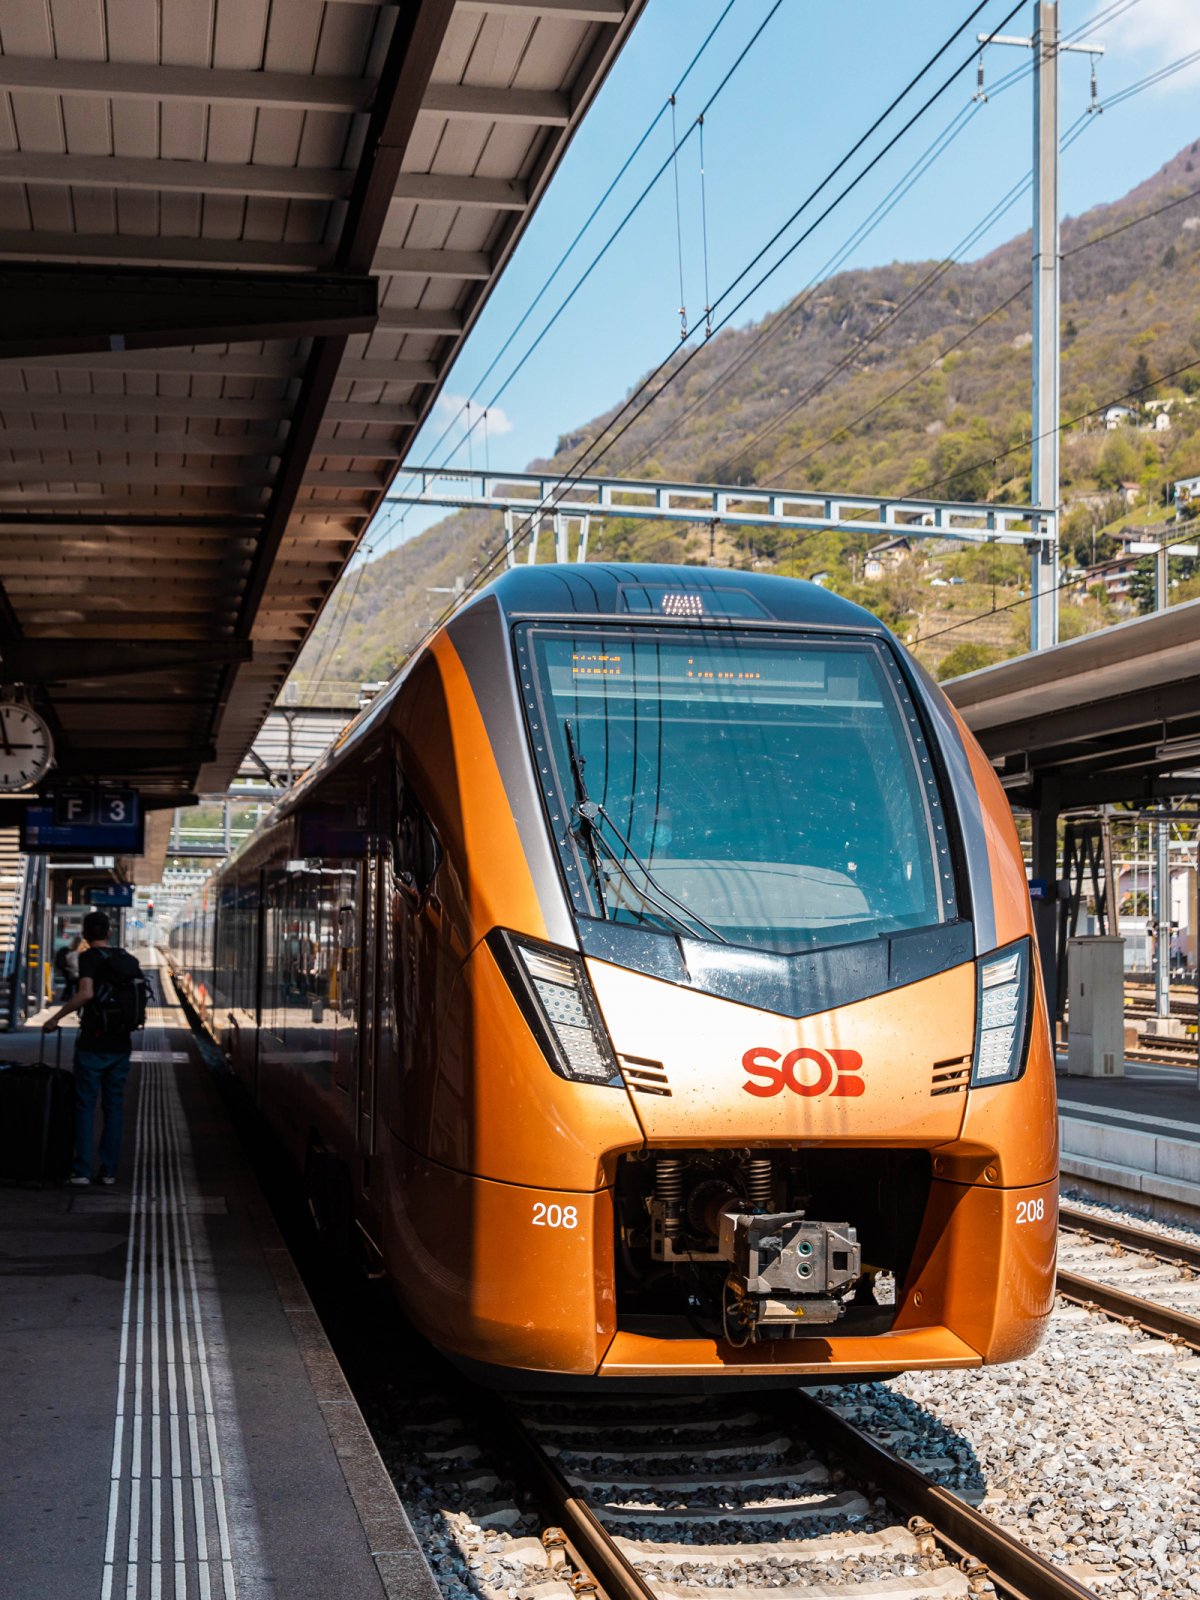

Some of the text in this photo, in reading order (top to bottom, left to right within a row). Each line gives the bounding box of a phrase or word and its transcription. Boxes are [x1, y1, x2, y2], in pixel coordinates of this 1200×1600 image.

[67, 799, 126, 821] F 3
[741, 1047, 866, 1098] SOB
[531, 1202, 578, 1229] 208
[1015, 1197, 1044, 1224] 208
